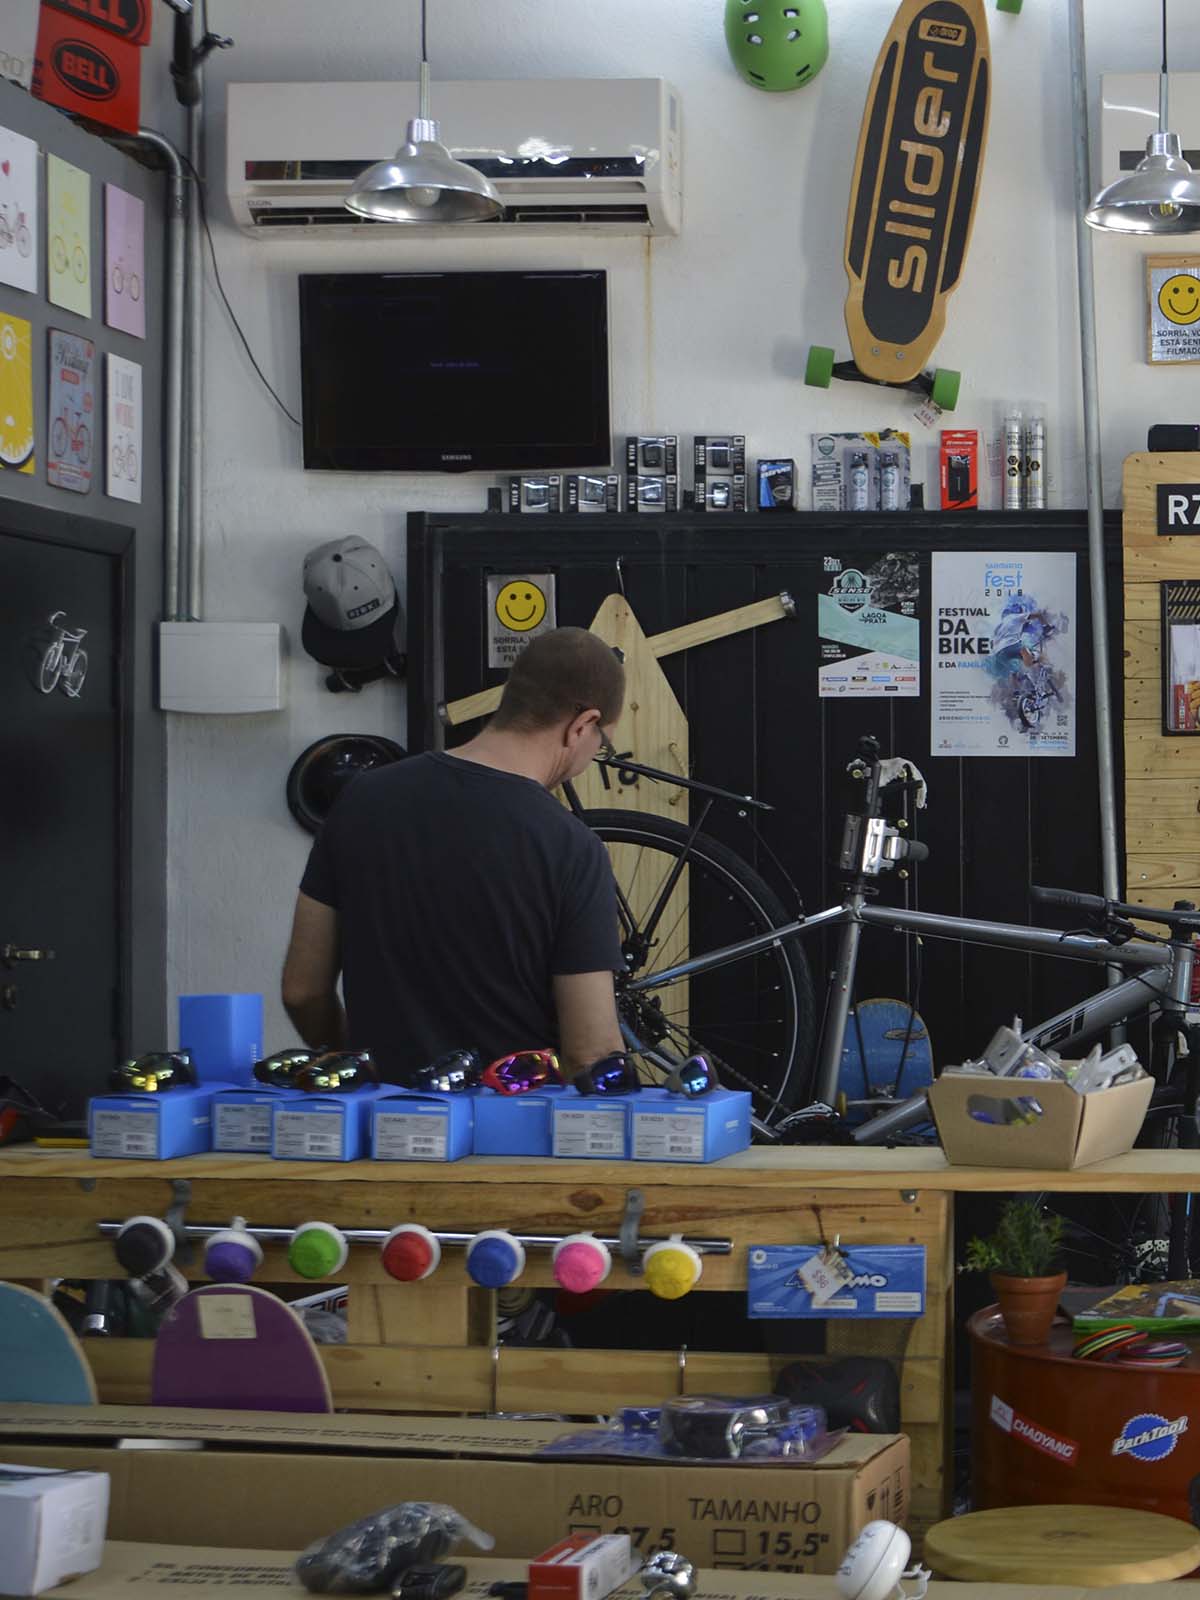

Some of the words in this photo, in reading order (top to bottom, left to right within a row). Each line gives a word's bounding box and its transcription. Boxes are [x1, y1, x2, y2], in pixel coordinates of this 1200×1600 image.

[61, 50, 111, 89] BELL
[885, 51, 958, 293] slider
[984, 571, 1023, 588] fest
[984, 589, 1023, 597] 2018
[938, 607, 991, 616] FESTIVAL
[938, 618, 970, 635] DA
[938, 637, 991, 655] BIKE
[1012, 1418, 1075, 1458] CHAOYANG
[568, 1494, 623, 1518] ARO
[688, 1497, 822, 1525] TAMANHO
